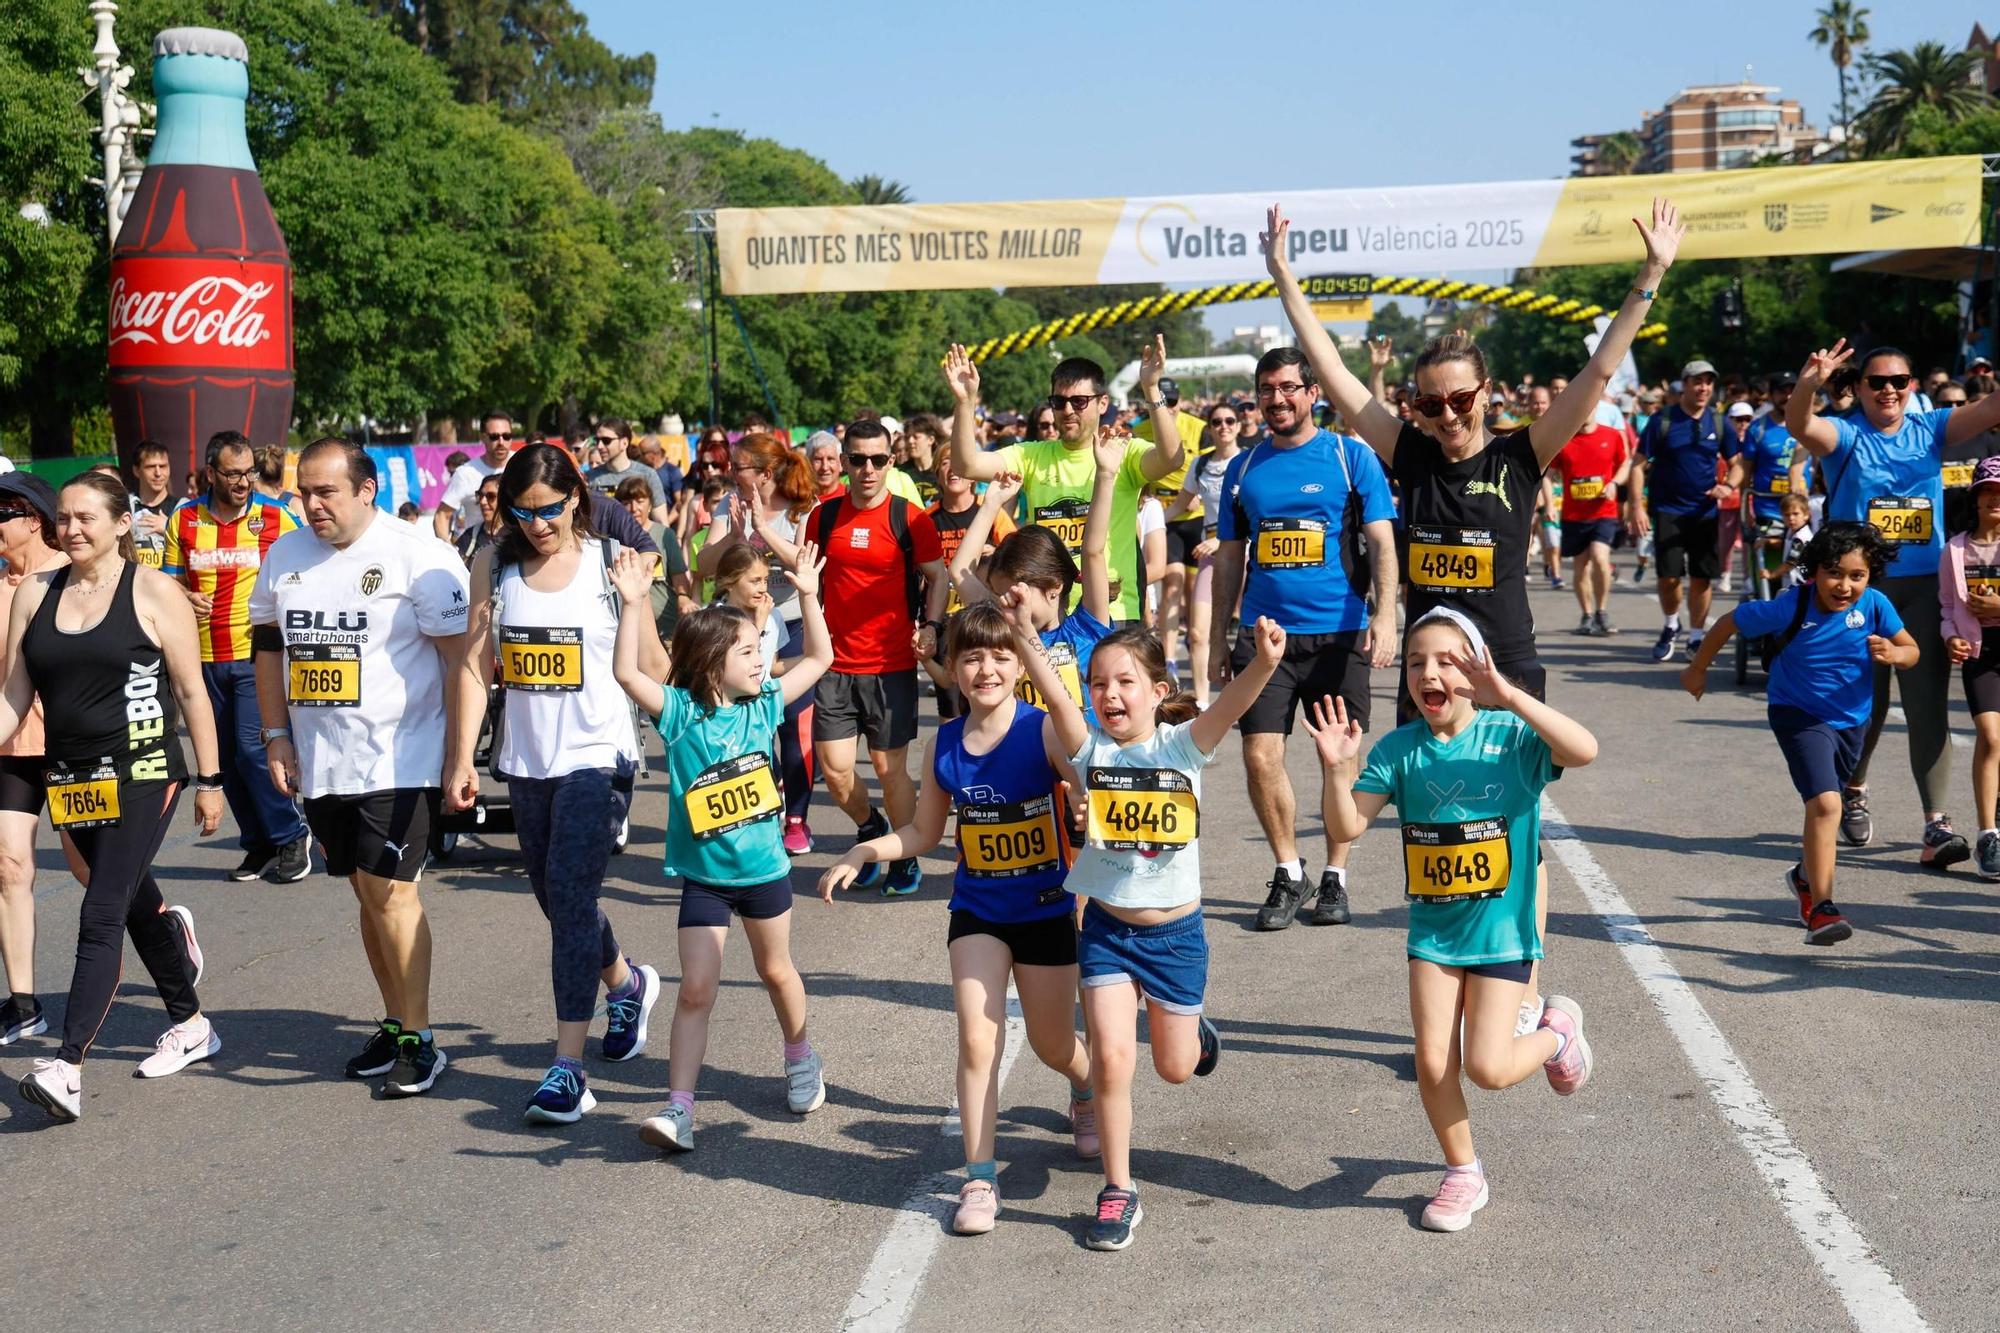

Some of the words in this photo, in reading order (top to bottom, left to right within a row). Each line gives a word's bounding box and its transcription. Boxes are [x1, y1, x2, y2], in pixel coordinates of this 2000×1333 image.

[747, 234, 847, 270] QUANTES
[855, 226, 902, 262] MÉS
[910, 230, 989, 261] VOLTES
[998, 228, 1082, 259] MILLOR
[1163, 226, 1247, 259] Volta
[1289, 228, 1348, 263] peu
[1357, 223, 1457, 251] València
[1465, 219, 1524, 247] 2025
[109, 276, 274, 347] Coca-Cola
[1882, 515, 1922, 534] 2648
[189, 549, 260, 569] betway
[1272, 537, 1306, 557] 5011
[1421, 552, 1477, 580] 4849
[287, 631, 368, 644] smartphones
[512, 652, 565, 677] 5008
[300, 669, 343, 693] 7669
[61, 789, 107, 816] 7664
[705, 781, 761, 820] 5015
[1106, 800, 1177, 833] 4846
[978, 827, 1046, 863] 5009
[1423, 852, 1491, 887] 4848
